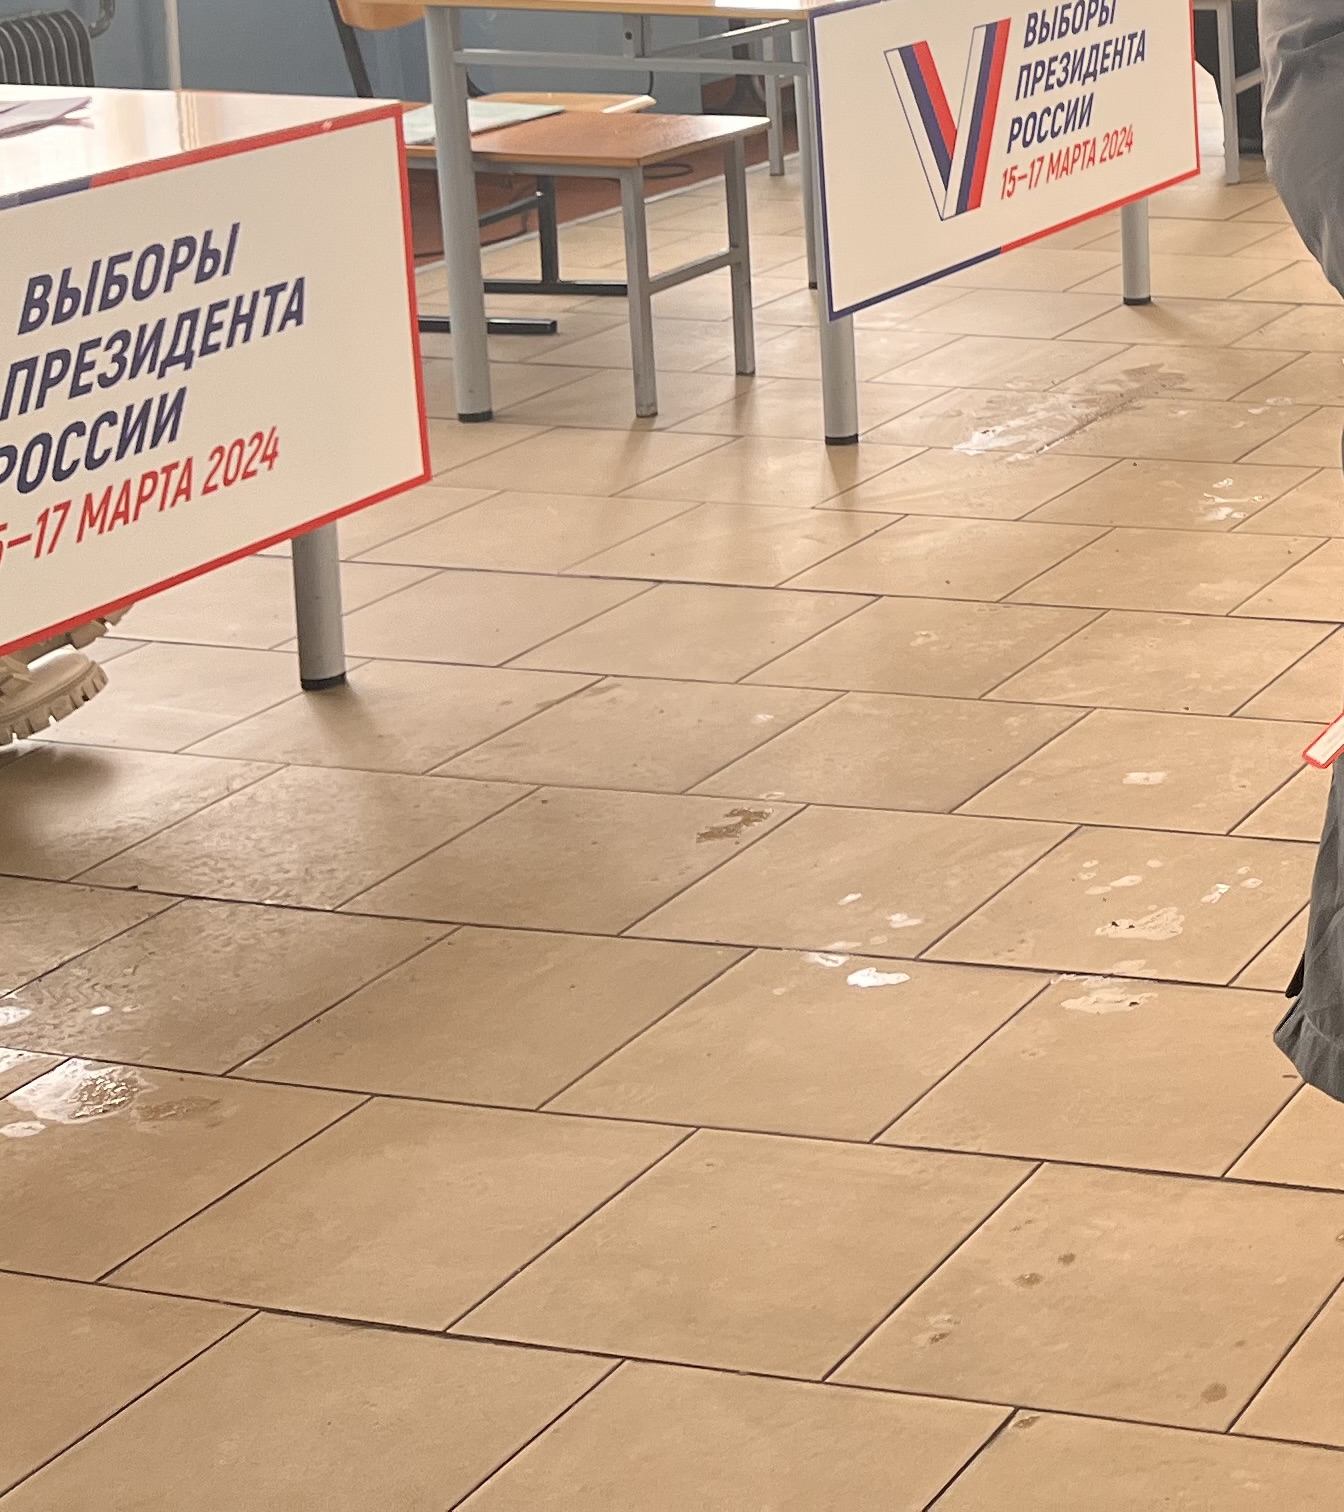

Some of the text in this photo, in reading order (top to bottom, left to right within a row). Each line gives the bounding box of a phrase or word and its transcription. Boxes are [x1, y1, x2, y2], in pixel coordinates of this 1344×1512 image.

[1014, 29, 1147, 102] ПРЕЗИДЕНТА
[1006, 92, 1095, 154] РОССИИ
[1045, 140, 1097, 184] МАРТА
[1098, 123, 1135, 166] 2024
[17, 222, 241, 336] ВЫБОРЫ
[0, 276, 307, 421] ПРЕЗИДЕНТА
[76, 456, 193, 544] МАРТА
[201, 425, 280, 496] 2024
